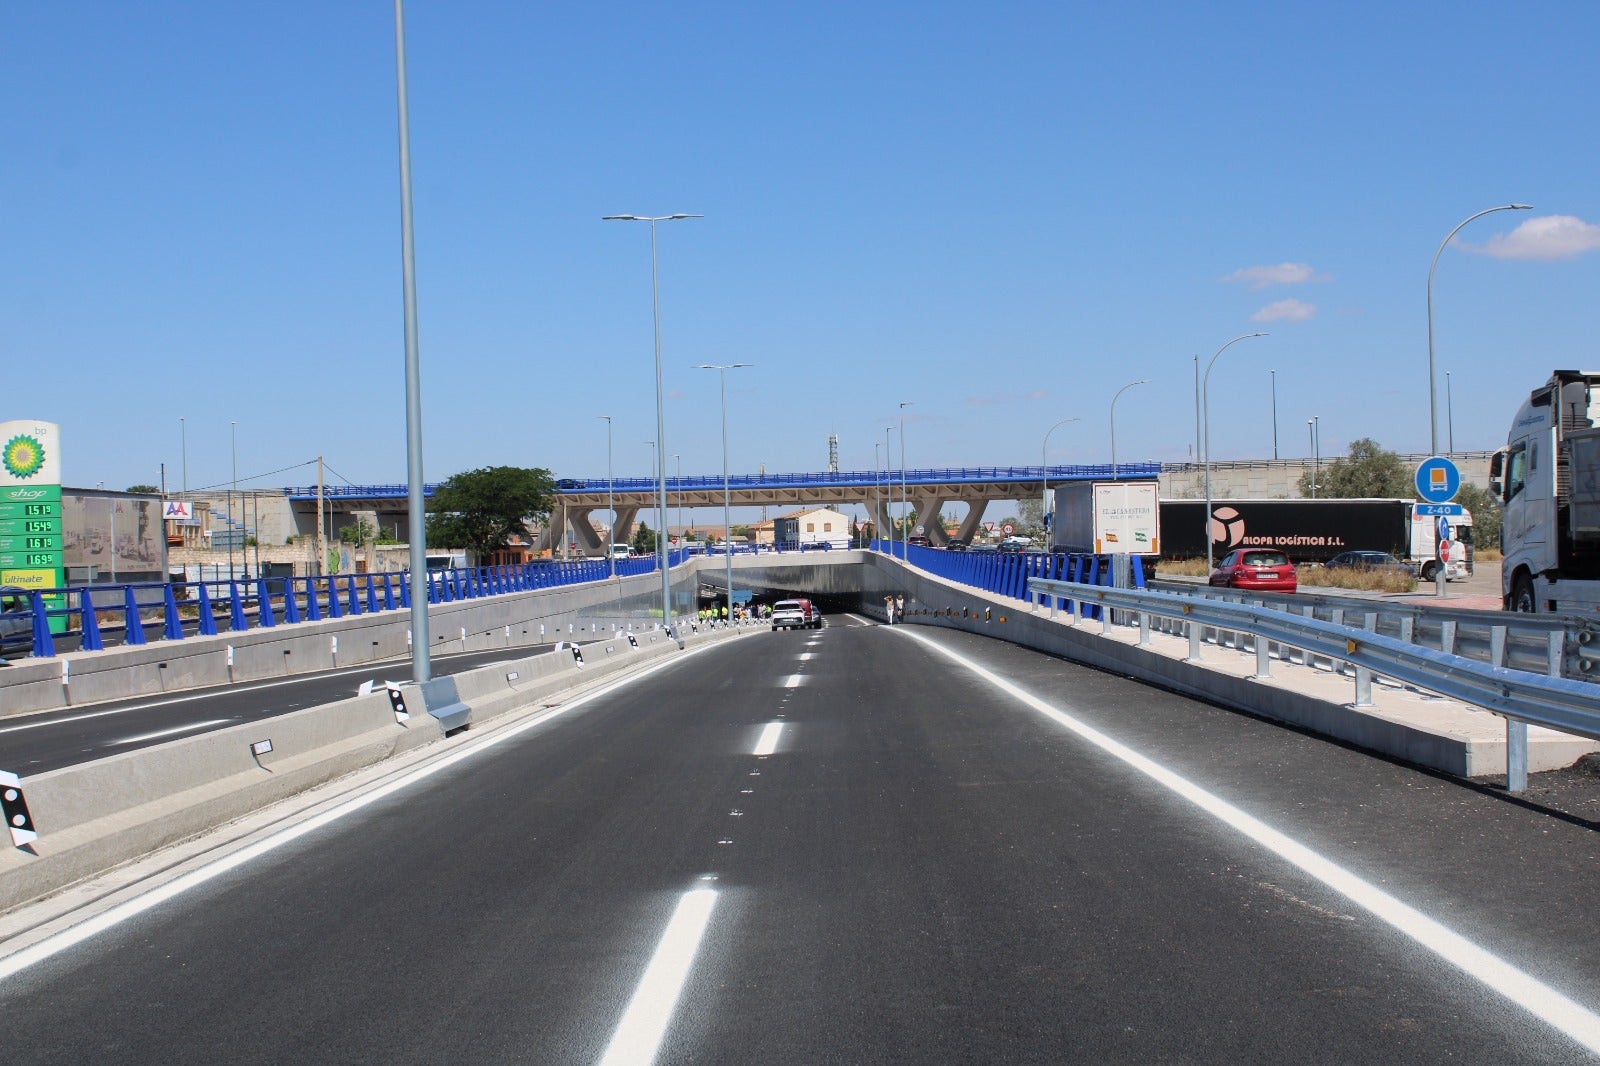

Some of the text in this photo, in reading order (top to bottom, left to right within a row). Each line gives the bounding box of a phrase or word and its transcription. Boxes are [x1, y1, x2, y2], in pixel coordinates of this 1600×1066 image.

[35, 427, 47, 436] bp
[10, 488, 47, 500] shop
[1427, 506, 1451, 514] Z-40
[1275, 535, 1325, 546] LOGÍSTICA
[1327, 536, 1345, 546] S.L.
[5, 575, 43, 583] ultimate
